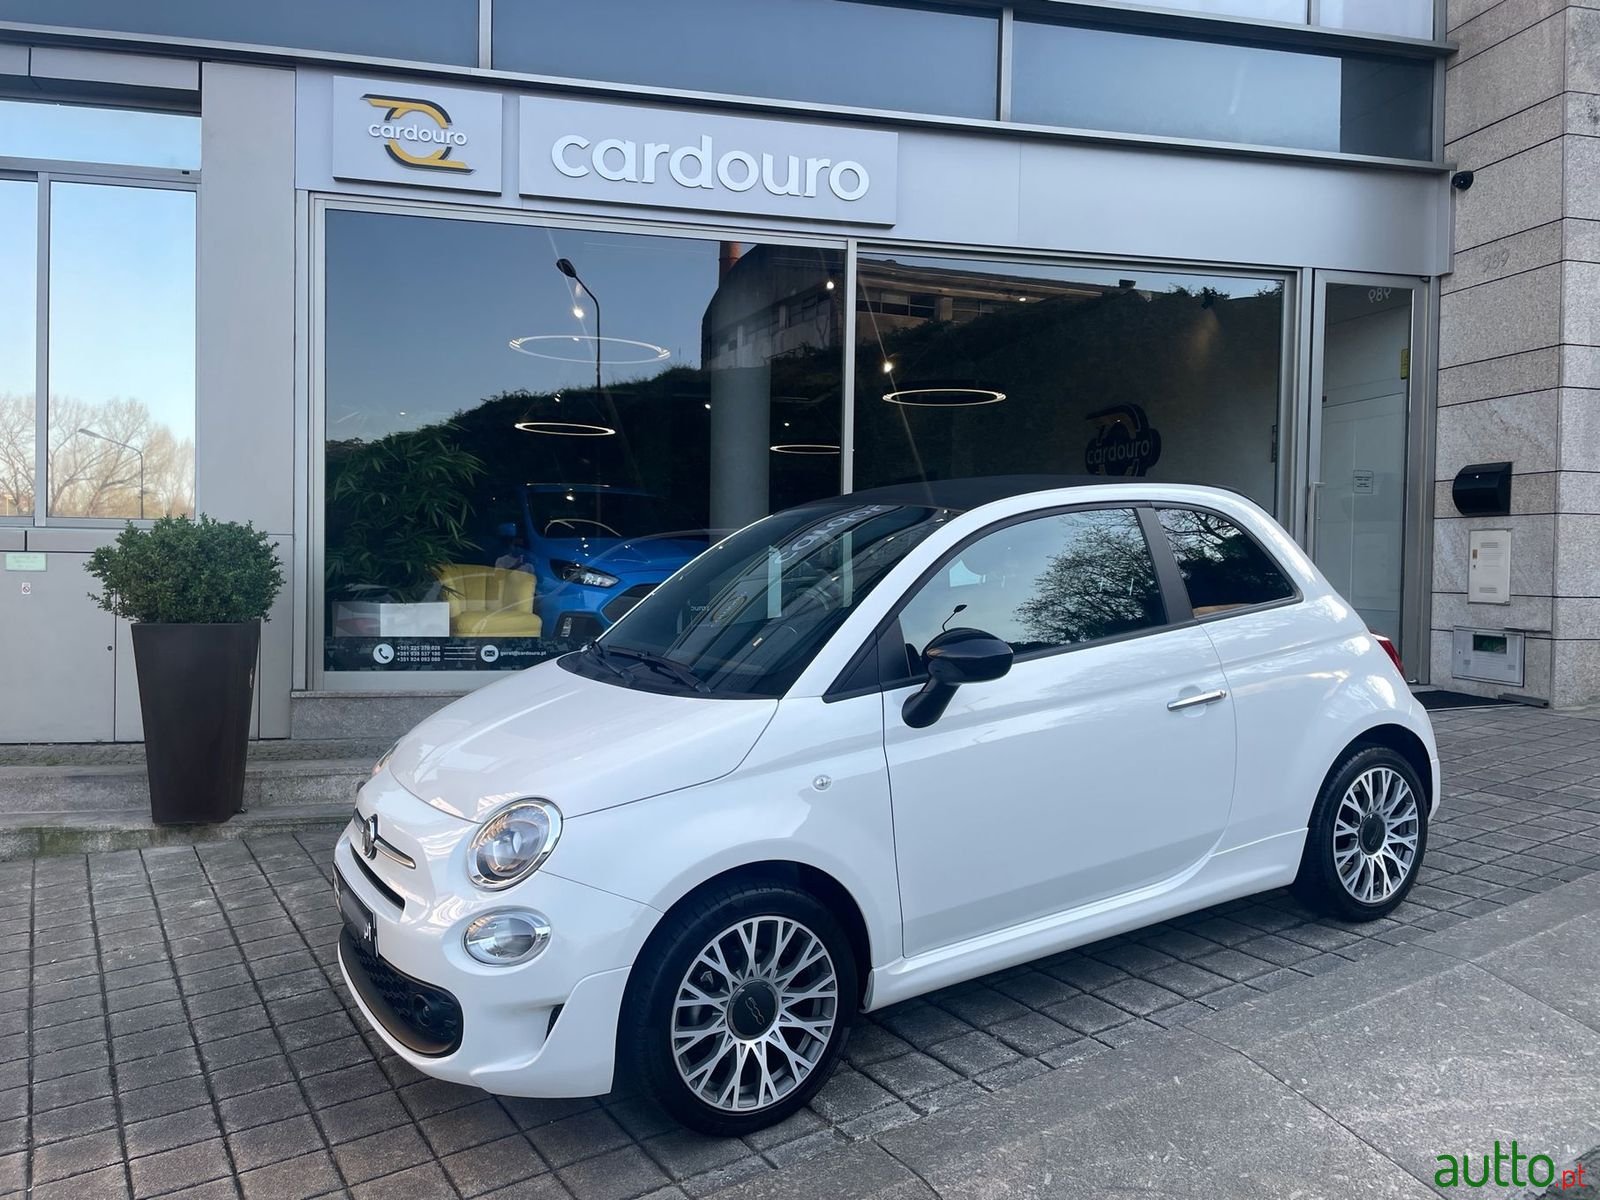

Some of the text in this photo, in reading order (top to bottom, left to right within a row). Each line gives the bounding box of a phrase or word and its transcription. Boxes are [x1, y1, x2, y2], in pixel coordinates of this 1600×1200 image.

[368, 123, 467, 146] cardouro
[551, 134, 870, 202] cardouro
[1087, 440, 1149, 464] cardouro
